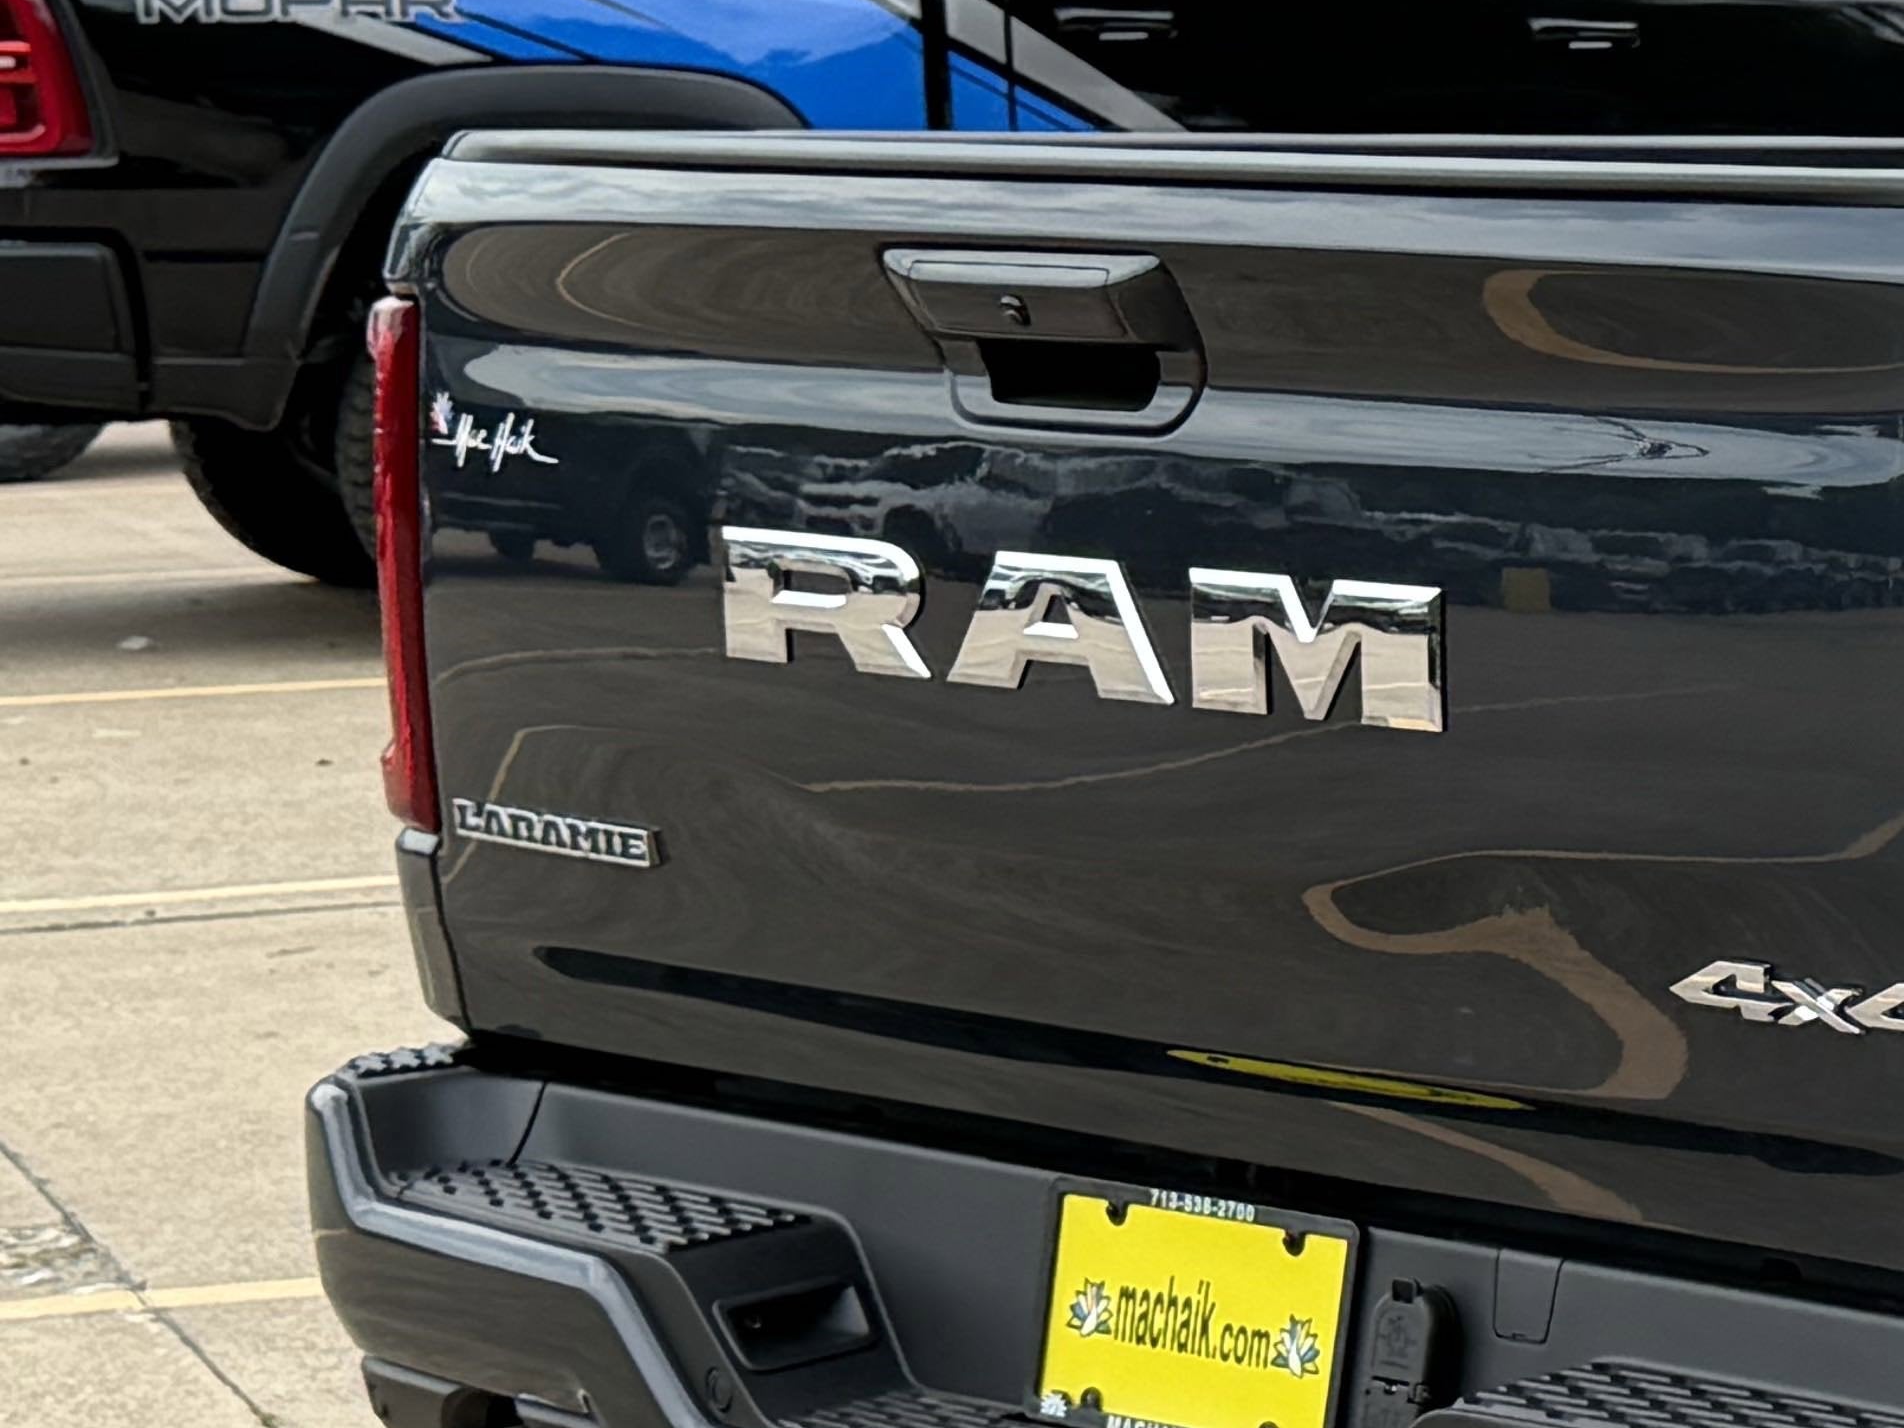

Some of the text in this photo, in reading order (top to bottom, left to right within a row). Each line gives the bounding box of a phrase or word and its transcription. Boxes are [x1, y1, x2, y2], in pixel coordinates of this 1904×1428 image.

[720, 525, 1445, 733] RAM
[452, 797, 651, 868] LARAMIE
[1112, 1274, 1272, 1369] machaik.com
